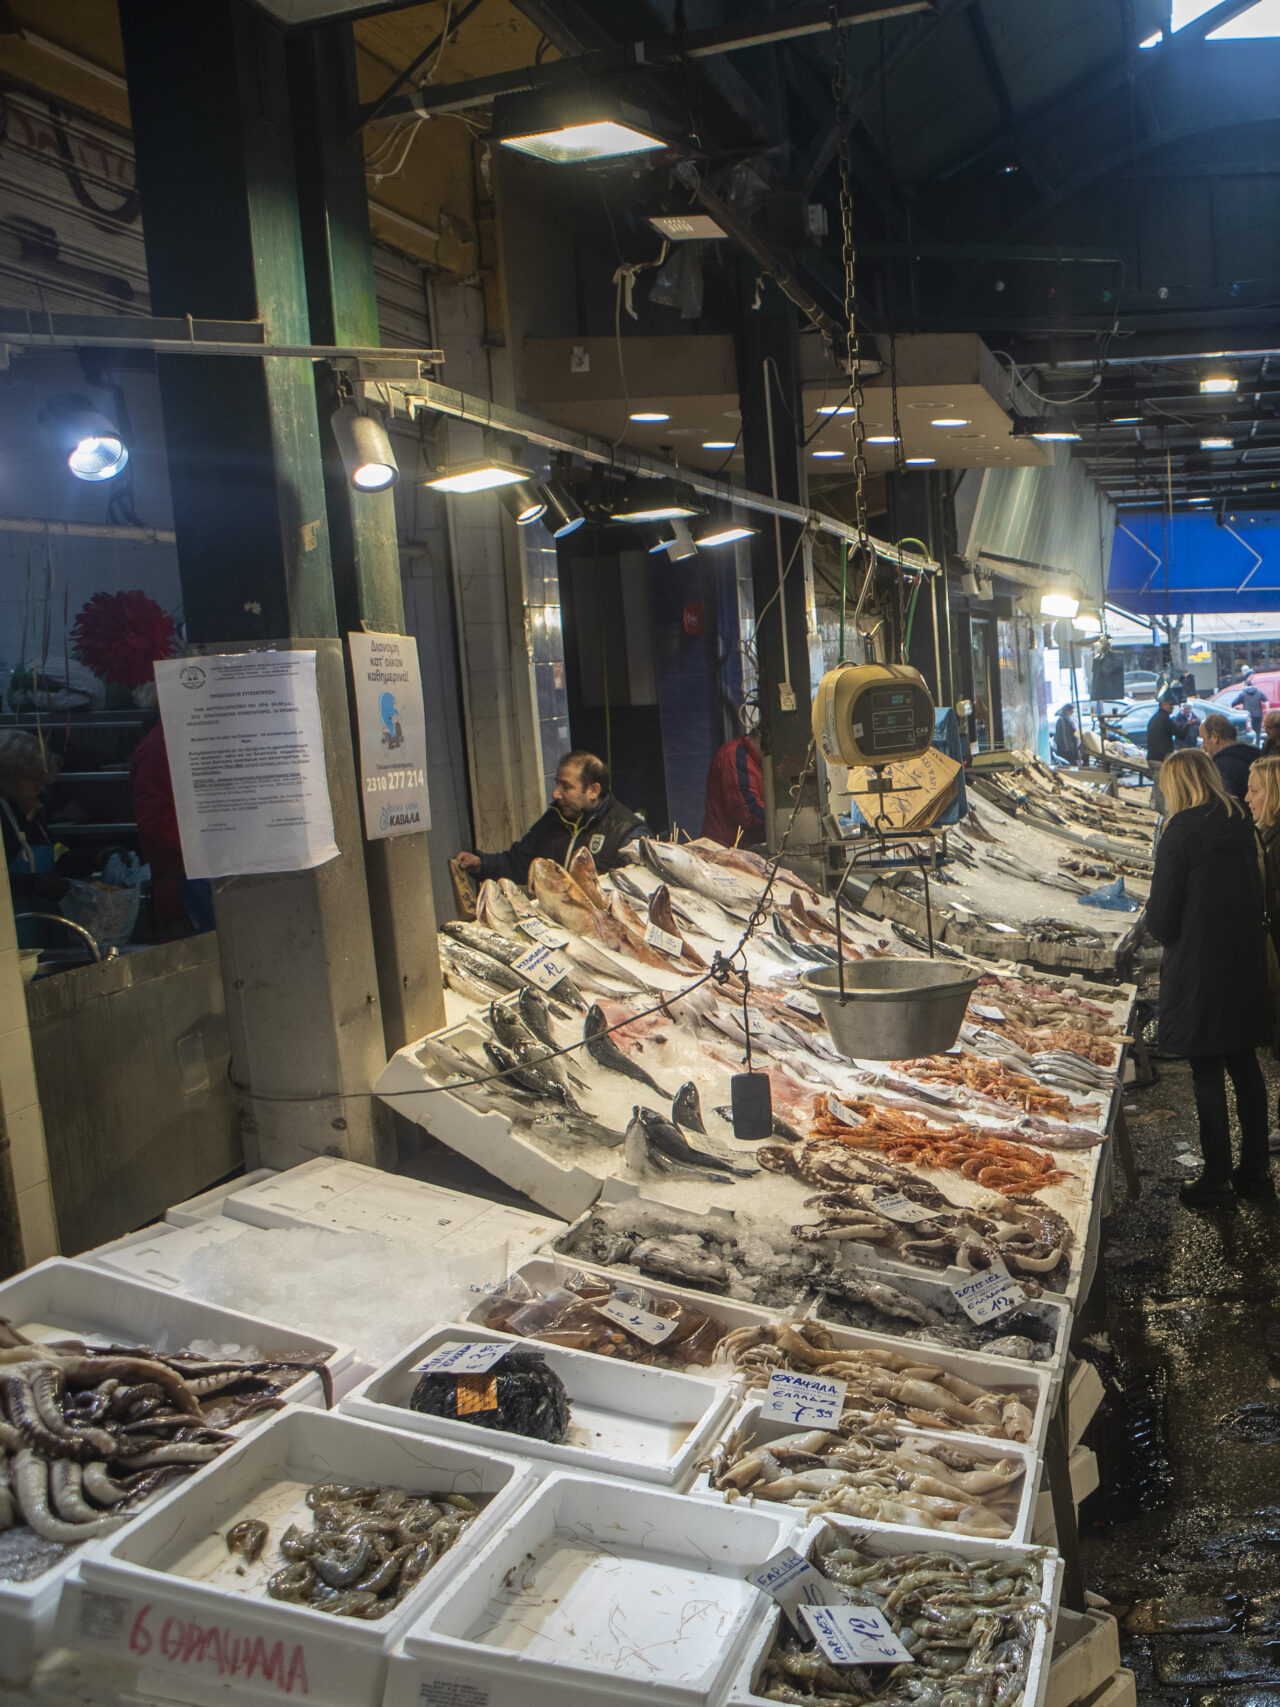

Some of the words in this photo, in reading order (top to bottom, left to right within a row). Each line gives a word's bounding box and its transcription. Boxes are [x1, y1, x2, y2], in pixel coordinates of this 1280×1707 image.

[366, 776, 387, 792] 2310
[387, 771, 405, 790] 277
[406, 769, 424, 788] 214
[389, 811, 420, 826] ΚΑΒΑΛΑ
